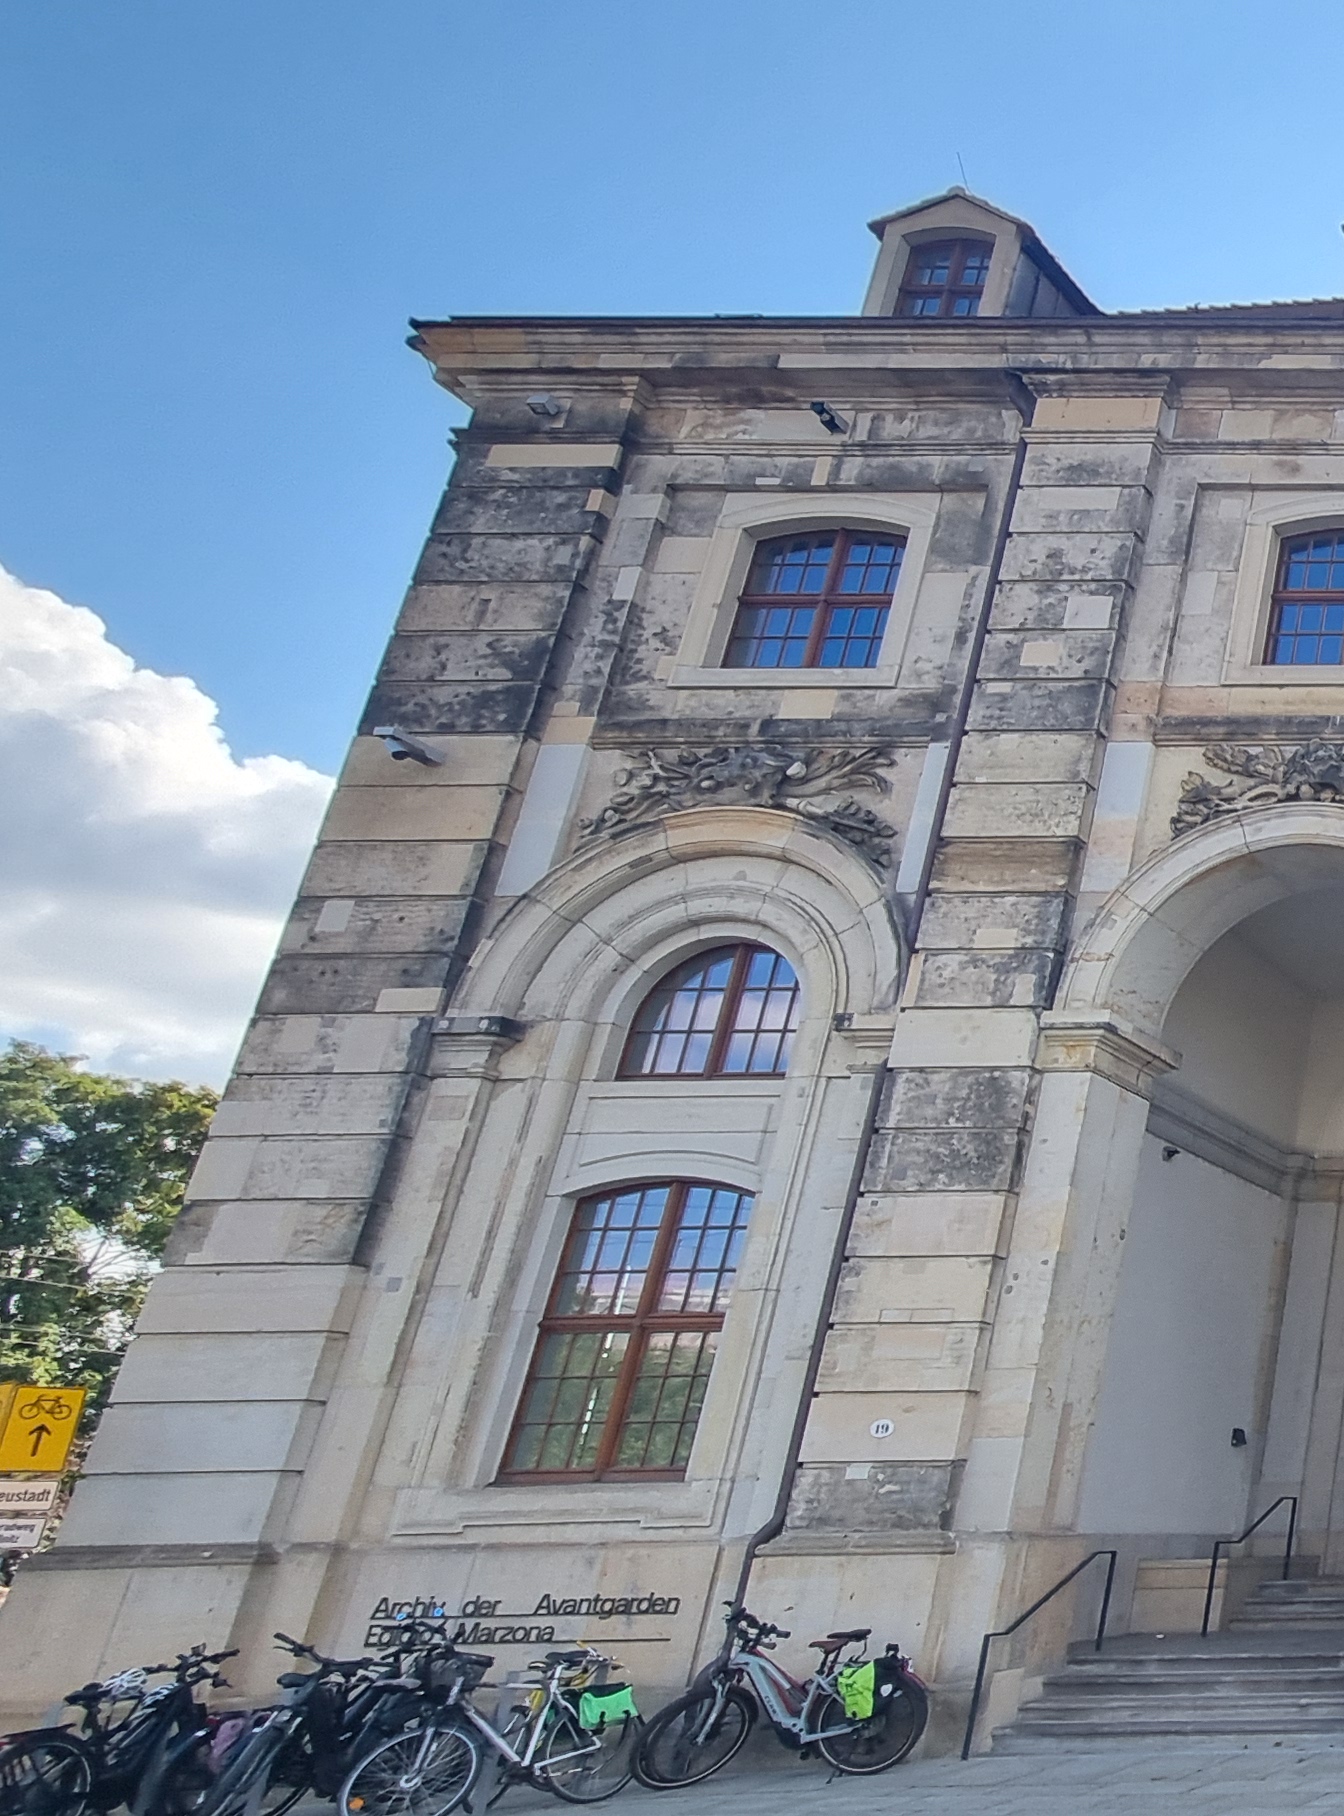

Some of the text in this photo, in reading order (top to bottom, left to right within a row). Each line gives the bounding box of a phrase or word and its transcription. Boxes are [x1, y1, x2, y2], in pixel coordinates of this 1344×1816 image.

[461, 1595, 502, 1617] der
[533, 1592, 681, 1619] Avantgarden
[454, 1621, 556, 1645] Marzona
